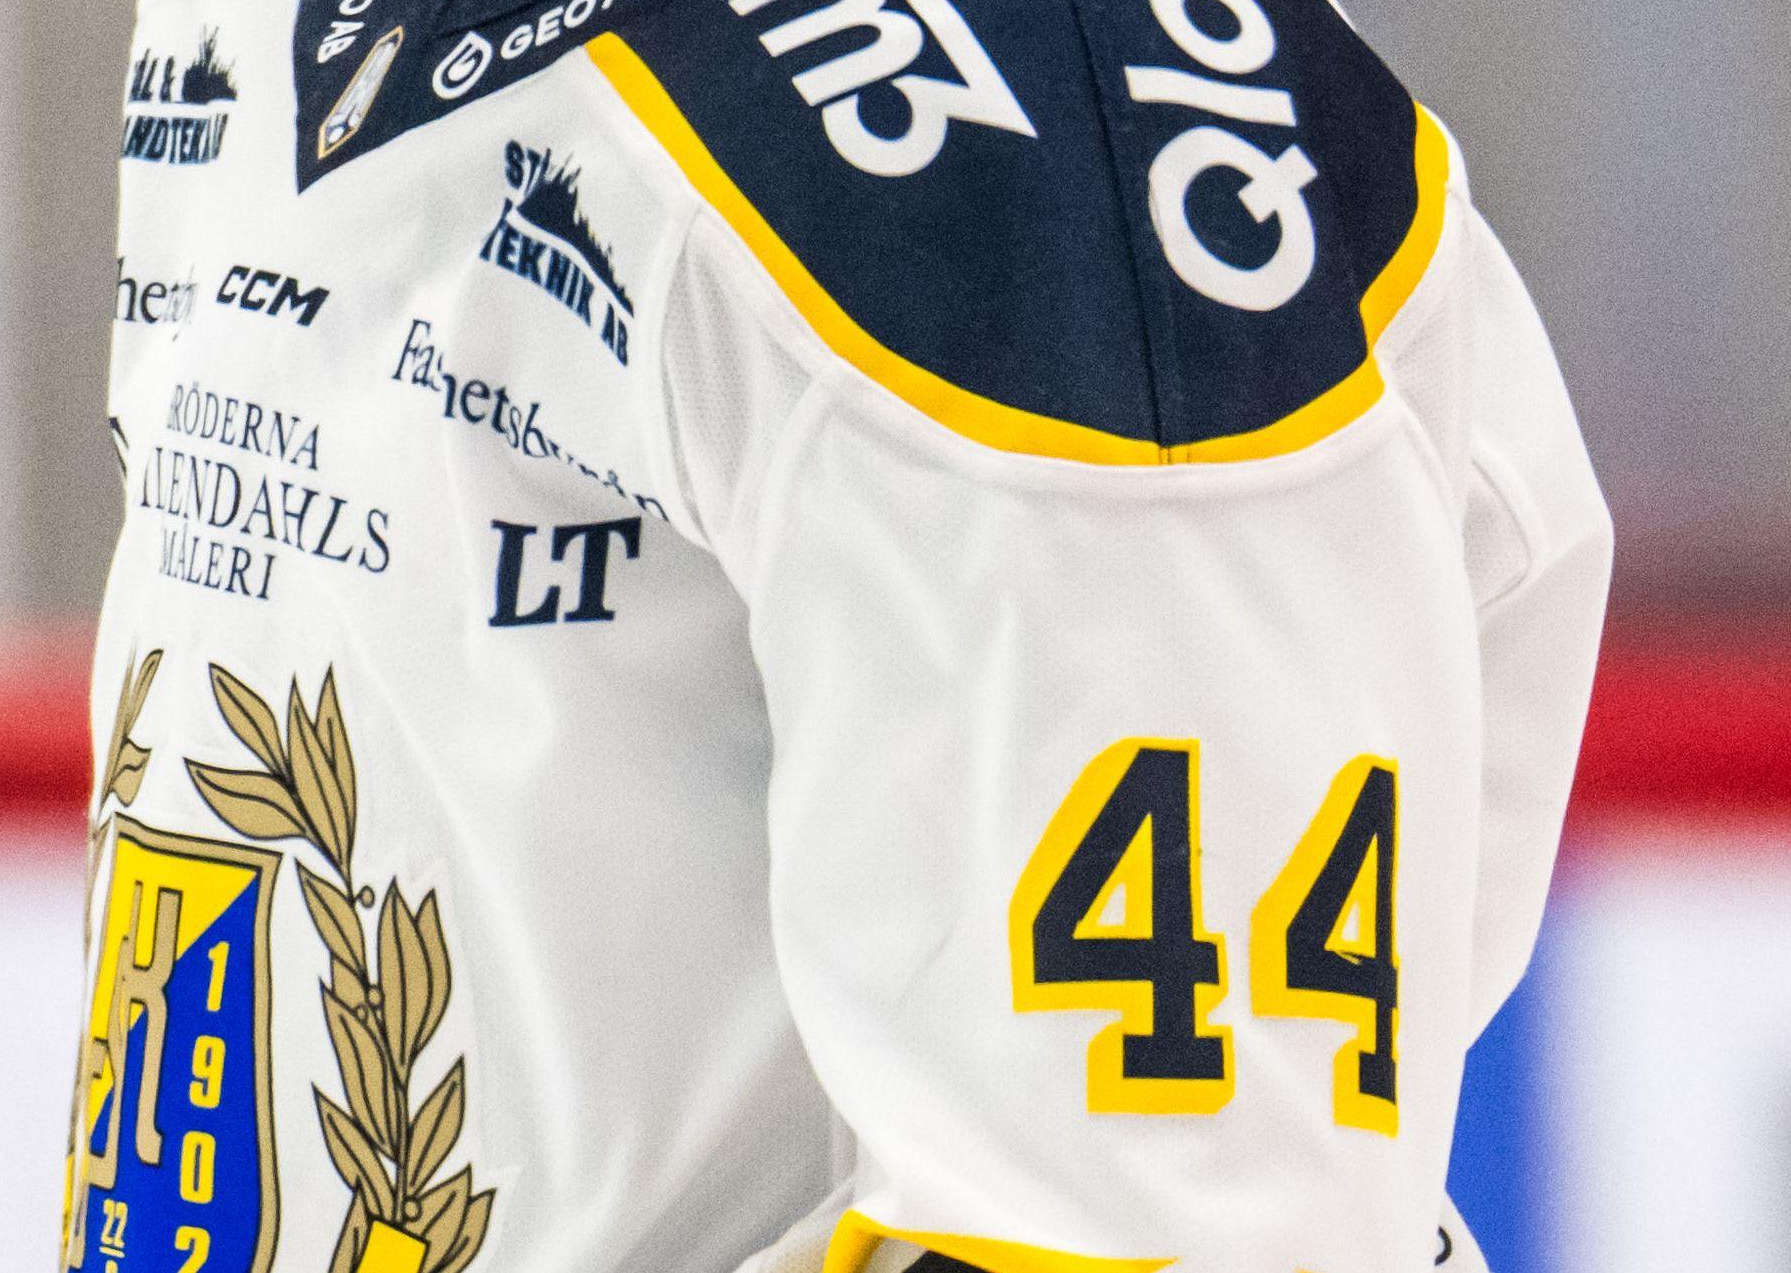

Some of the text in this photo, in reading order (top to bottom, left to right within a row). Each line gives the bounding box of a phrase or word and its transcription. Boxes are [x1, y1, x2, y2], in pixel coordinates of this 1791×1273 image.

[216, 265, 330, 327] CCM
[488, 517, 642, 628] LT
[1009, 737, 1400, 1138] 44
